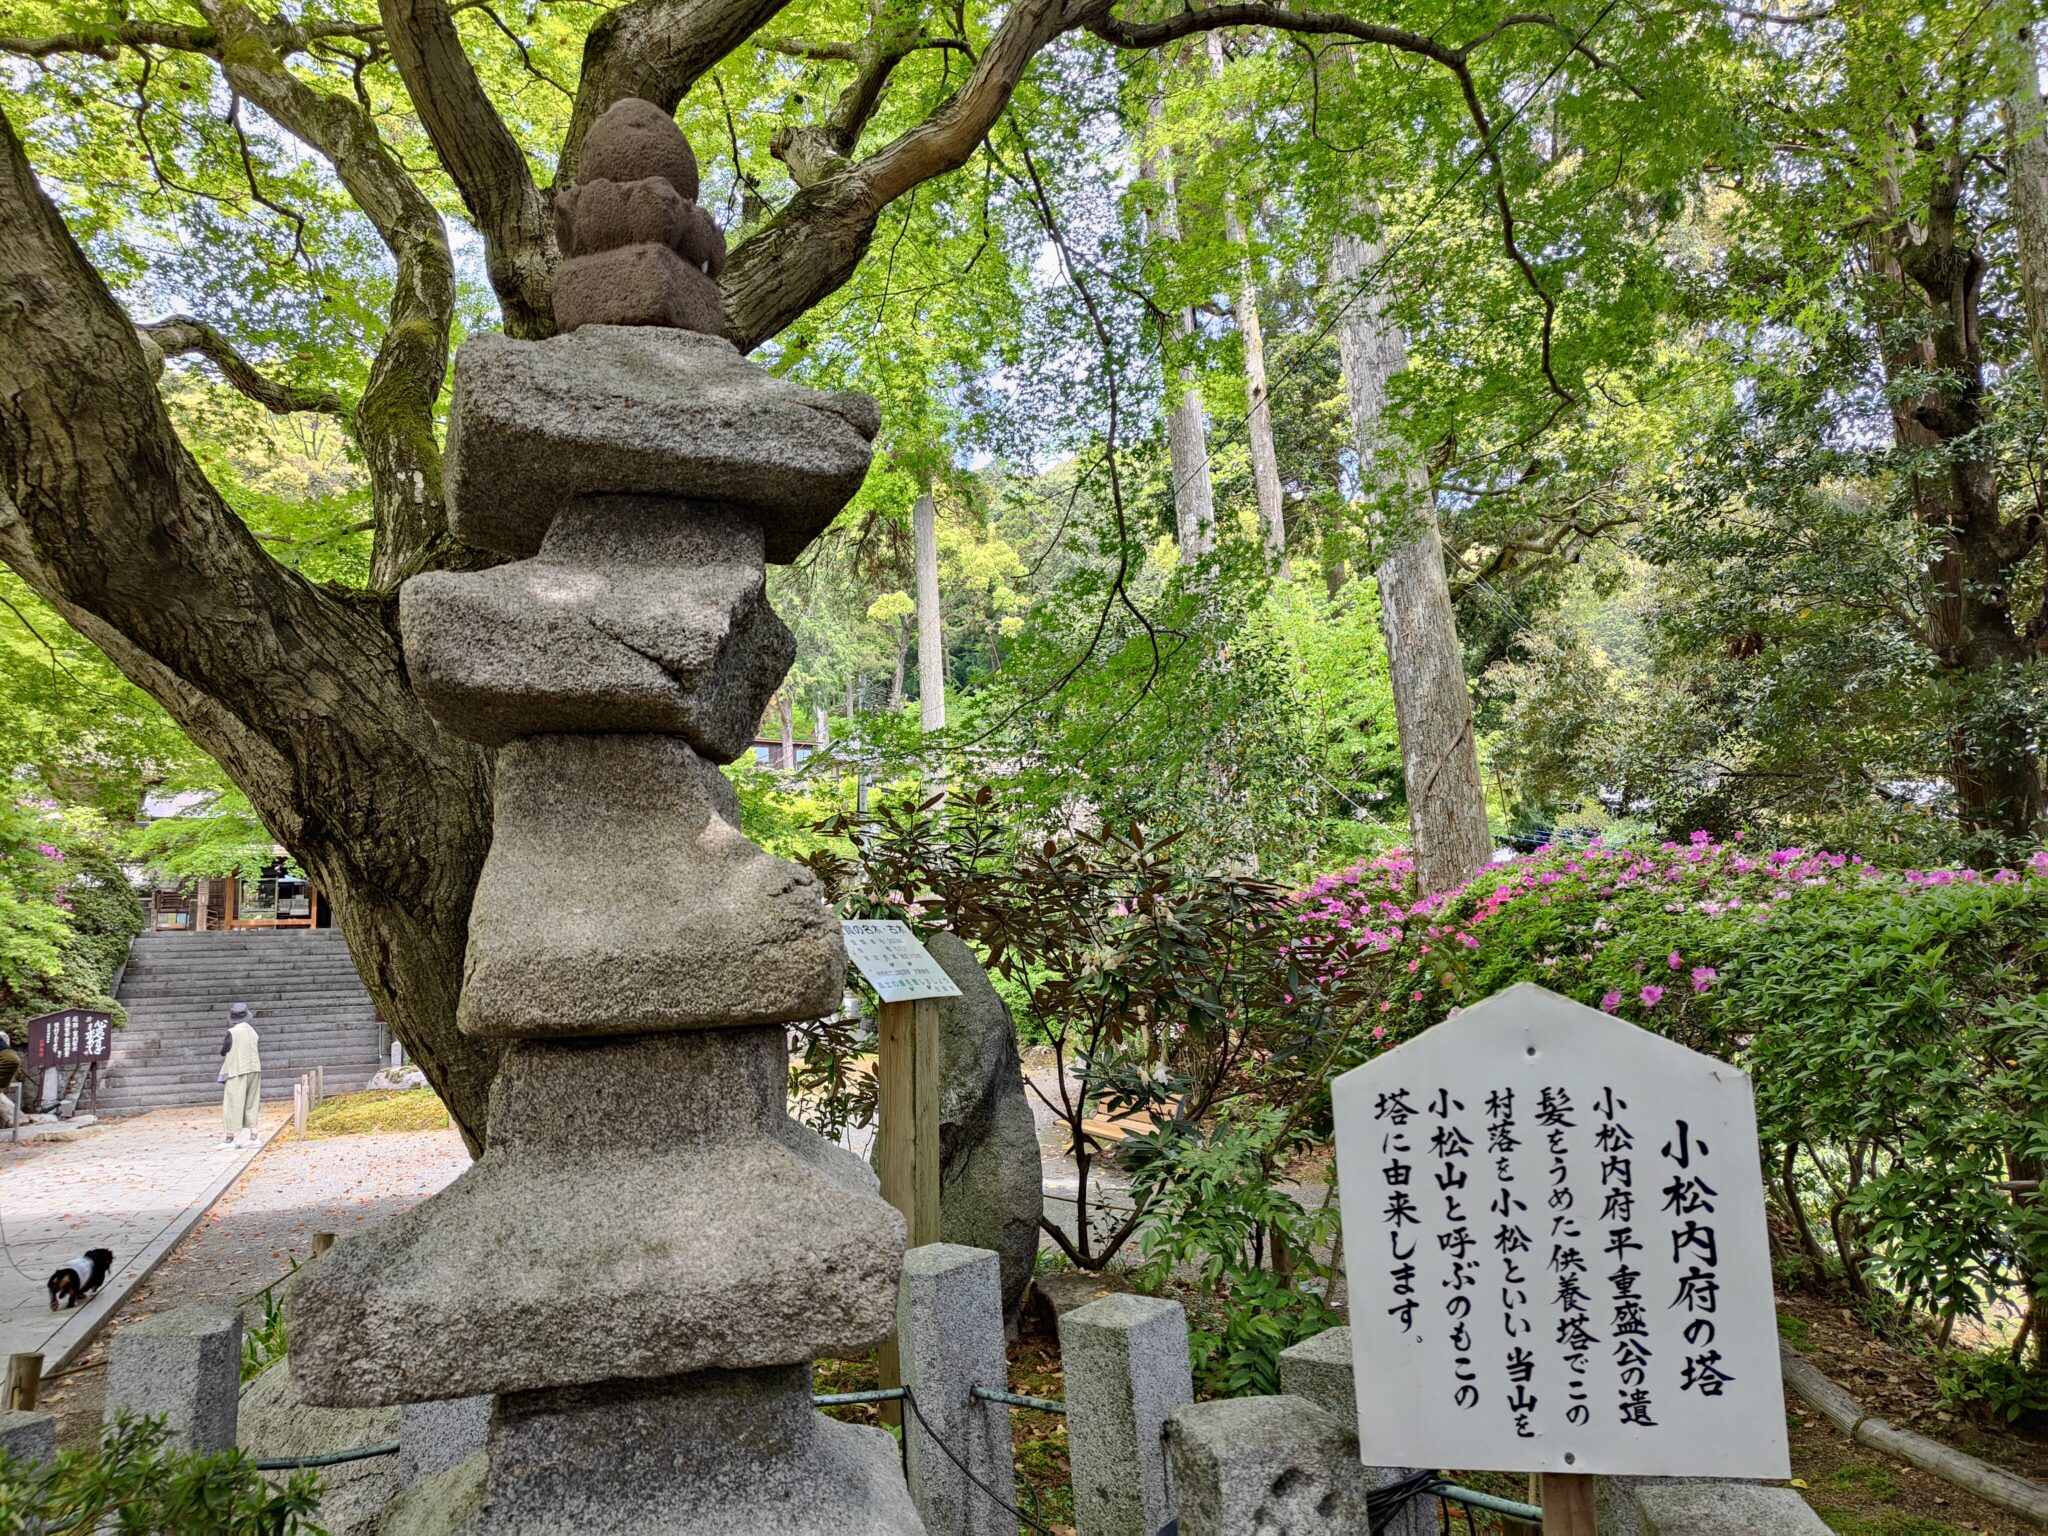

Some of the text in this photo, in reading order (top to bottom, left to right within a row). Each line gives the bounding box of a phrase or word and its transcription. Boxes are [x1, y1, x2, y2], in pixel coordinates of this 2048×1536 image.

[843, 924, 907, 935] 賀の名木・古木
[1374, 1087, 1423, 1344] 塔に由来します。
[1428, 1087, 1480, 1409] 小松山と呼ぶのもこの
[1484, 1086, 1538, 1438] 村落を小松といい当山を
[1534, 1086, 1601, 1426] 髪をうめた供養塔でこの
[1593, 1086, 1659, 1427] 小松内府平重盛公の遺
[1661, 1119, 1736, 1397] 小松内府の塔
